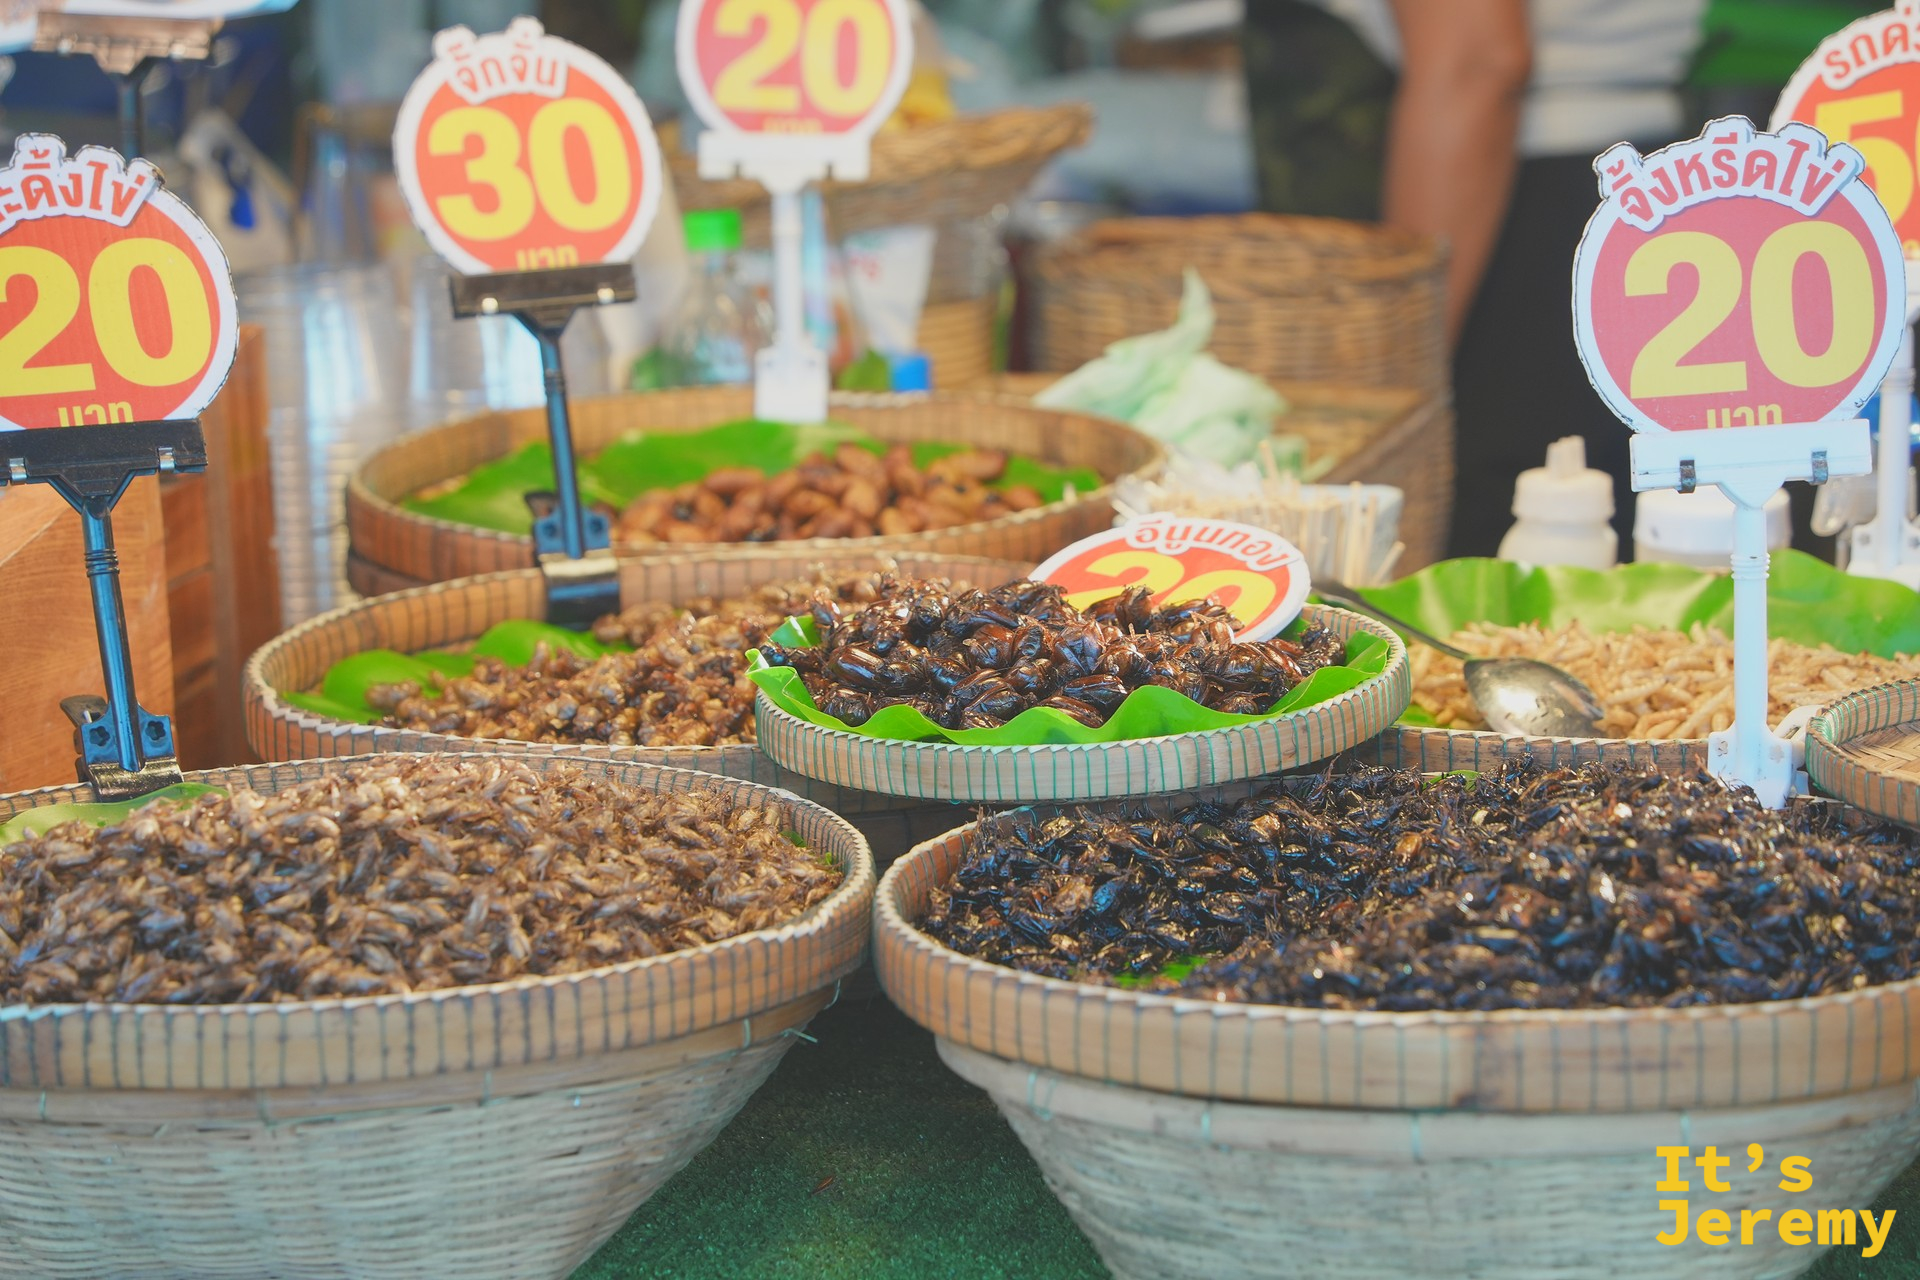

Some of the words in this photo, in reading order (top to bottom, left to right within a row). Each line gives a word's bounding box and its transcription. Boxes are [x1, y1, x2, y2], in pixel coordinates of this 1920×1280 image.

[714, 0, 891, 117] 20
[0, 149, 147, 223] ะดิ้งไข่
[427, 98, 631, 240] 30
[1606, 132, 1846, 222] จิ้งหรีดไข่
[1815, 90, 1920, 225] 5
[0, 237, 212, 398] 20
[1624, 221, 1875, 398] 20
